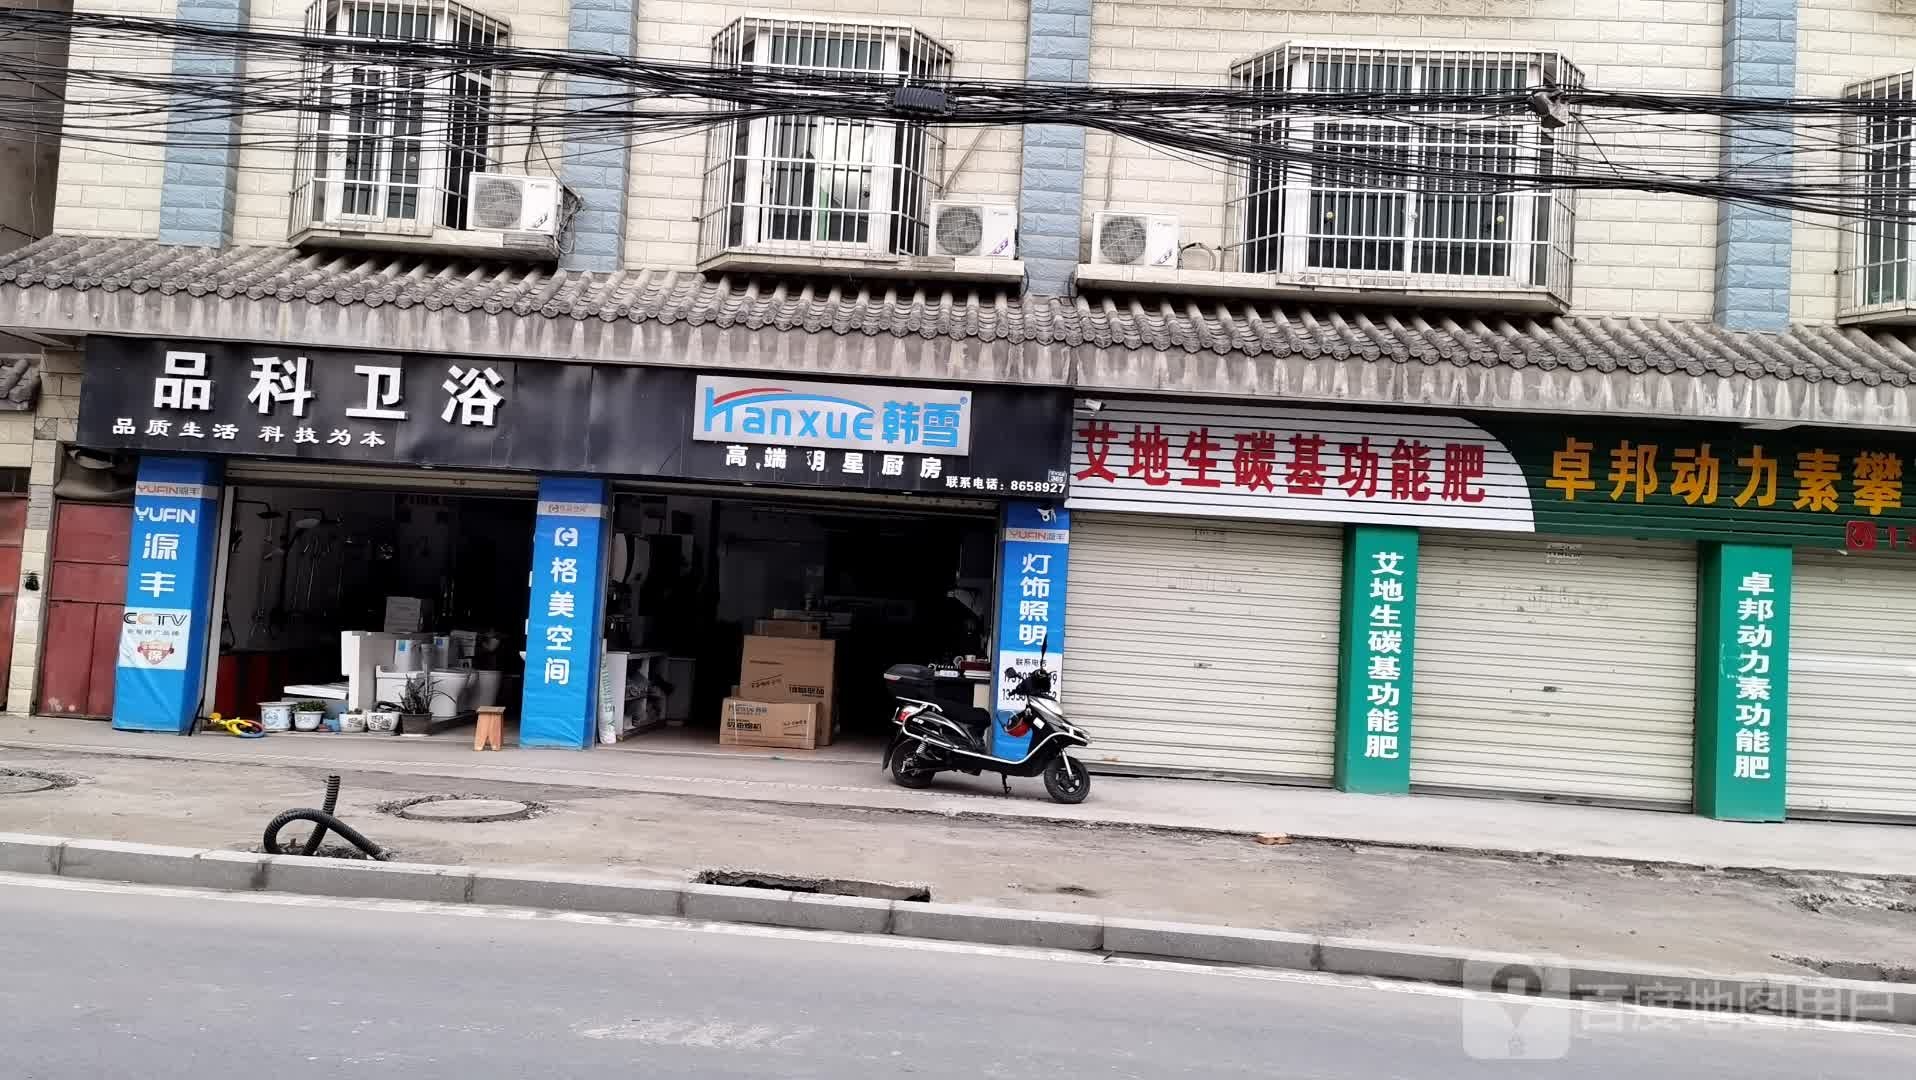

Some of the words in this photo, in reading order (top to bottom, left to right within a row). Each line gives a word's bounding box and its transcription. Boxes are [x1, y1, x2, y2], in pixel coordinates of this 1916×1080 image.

[153, 350, 504, 427] 品科卫浴
[882, 400, 961, 448] 韩雪
[112, 417, 239, 441] 品质生活
[258, 425, 386, 448] 科技为本
[1075, 420, 1486, 503] 艾地生碳基功能肥
[135, 505, 197, 524] YUFIN
[1545, 436, 1916, 516] 卓邦动力素攀
[139, 531, 181, 598] 源丰
[1018, 552, 1052, 646] 灯饰照明
[543, 556, 578, 685] 格美空间
[1364, 551, 1405, 760] 艾地生碳基功能肥
[1733, 571, 1775, 780] 卓邦动力素功能肥
